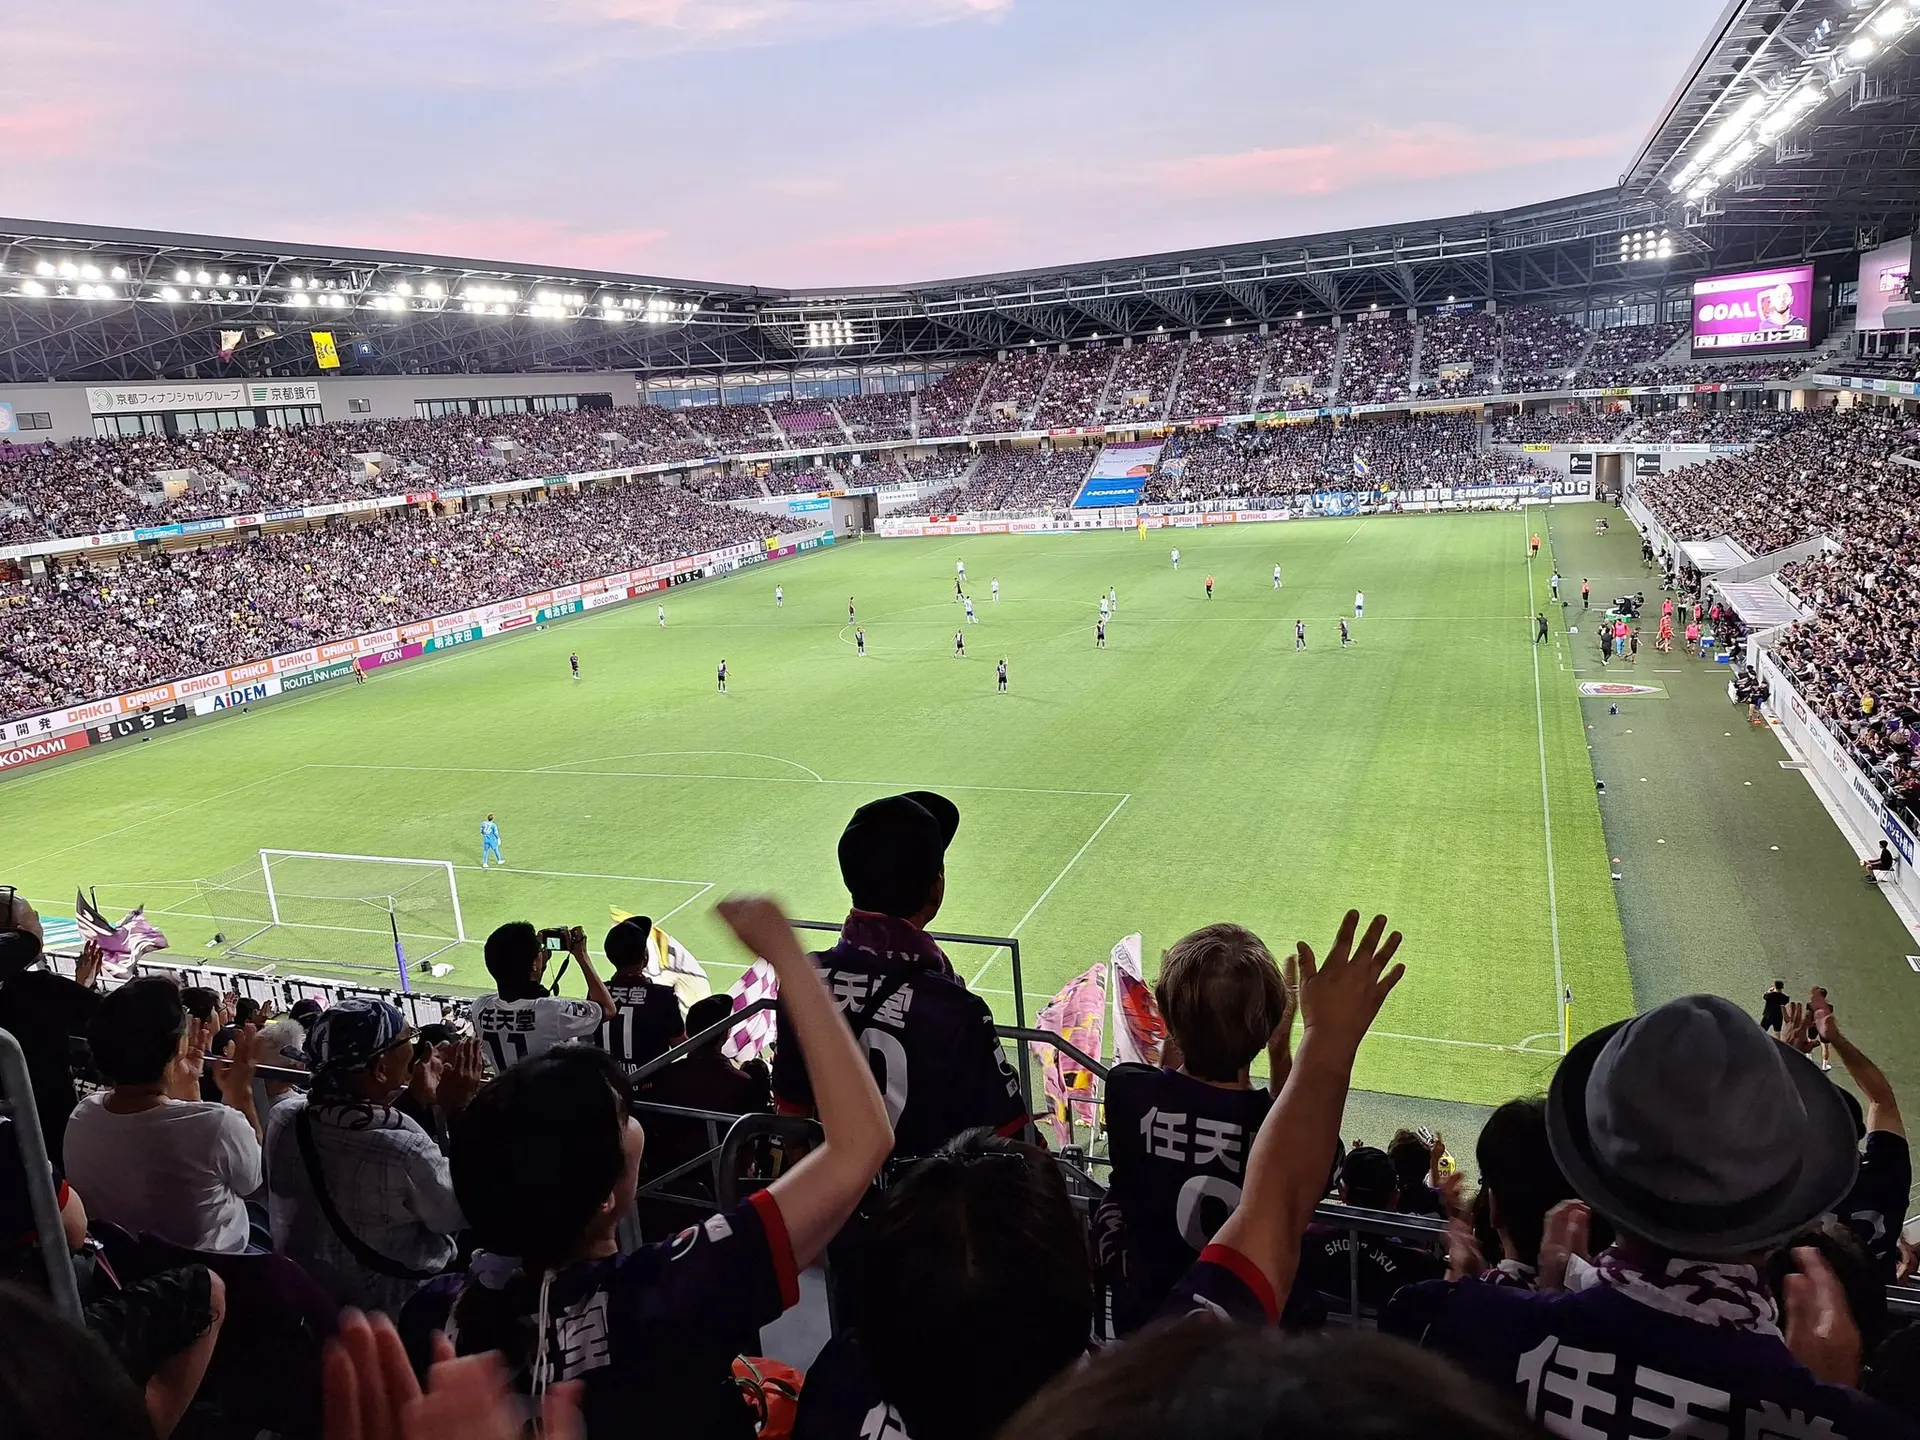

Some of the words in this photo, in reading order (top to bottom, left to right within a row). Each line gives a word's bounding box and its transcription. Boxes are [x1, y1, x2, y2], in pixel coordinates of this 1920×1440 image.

[1699, 301, 1757, 322] GOAL
[115, 388, 241, 406] 京都フィナンシャルグループ
[270, 385, 317, 401] 京都銀行
[676, 570, 700, 584] いちご
[635, 582, 660, 595] KONAMI
[592, 593, 619, 606] docomo
[544, 603, 576, 619] 明治安田
[437, 615, 464, 629] DAIKO
[363, 632, 393, 647] DAIKO
[434, 629, 473, 649] 明治安田
[321, 641, 355, 658] DAIKO
[278, 652, 313, 669] DAIKO
[231, 662, 268, 681] DAIKO
[284, 674, 313, 691] ROUTE
[314, 669, 330, 683] INN
[330, 665, 354, 677] HOTELS
[181, 675, 220, 693] DAIKO
[126, 687, 170, 709] DAIKO
[67, 702, 113, 724] DAIKO
[117, 707, 178, 736] いちご
[0, 738, 67, 767] KONAMI
[606, 985, 647, 1005] 天堂
[815, 967, 914, 1029] 天堂
[477, 1008, 536, 1033] 任天堂
[1139, 1106, 1249, 1173] 任天
